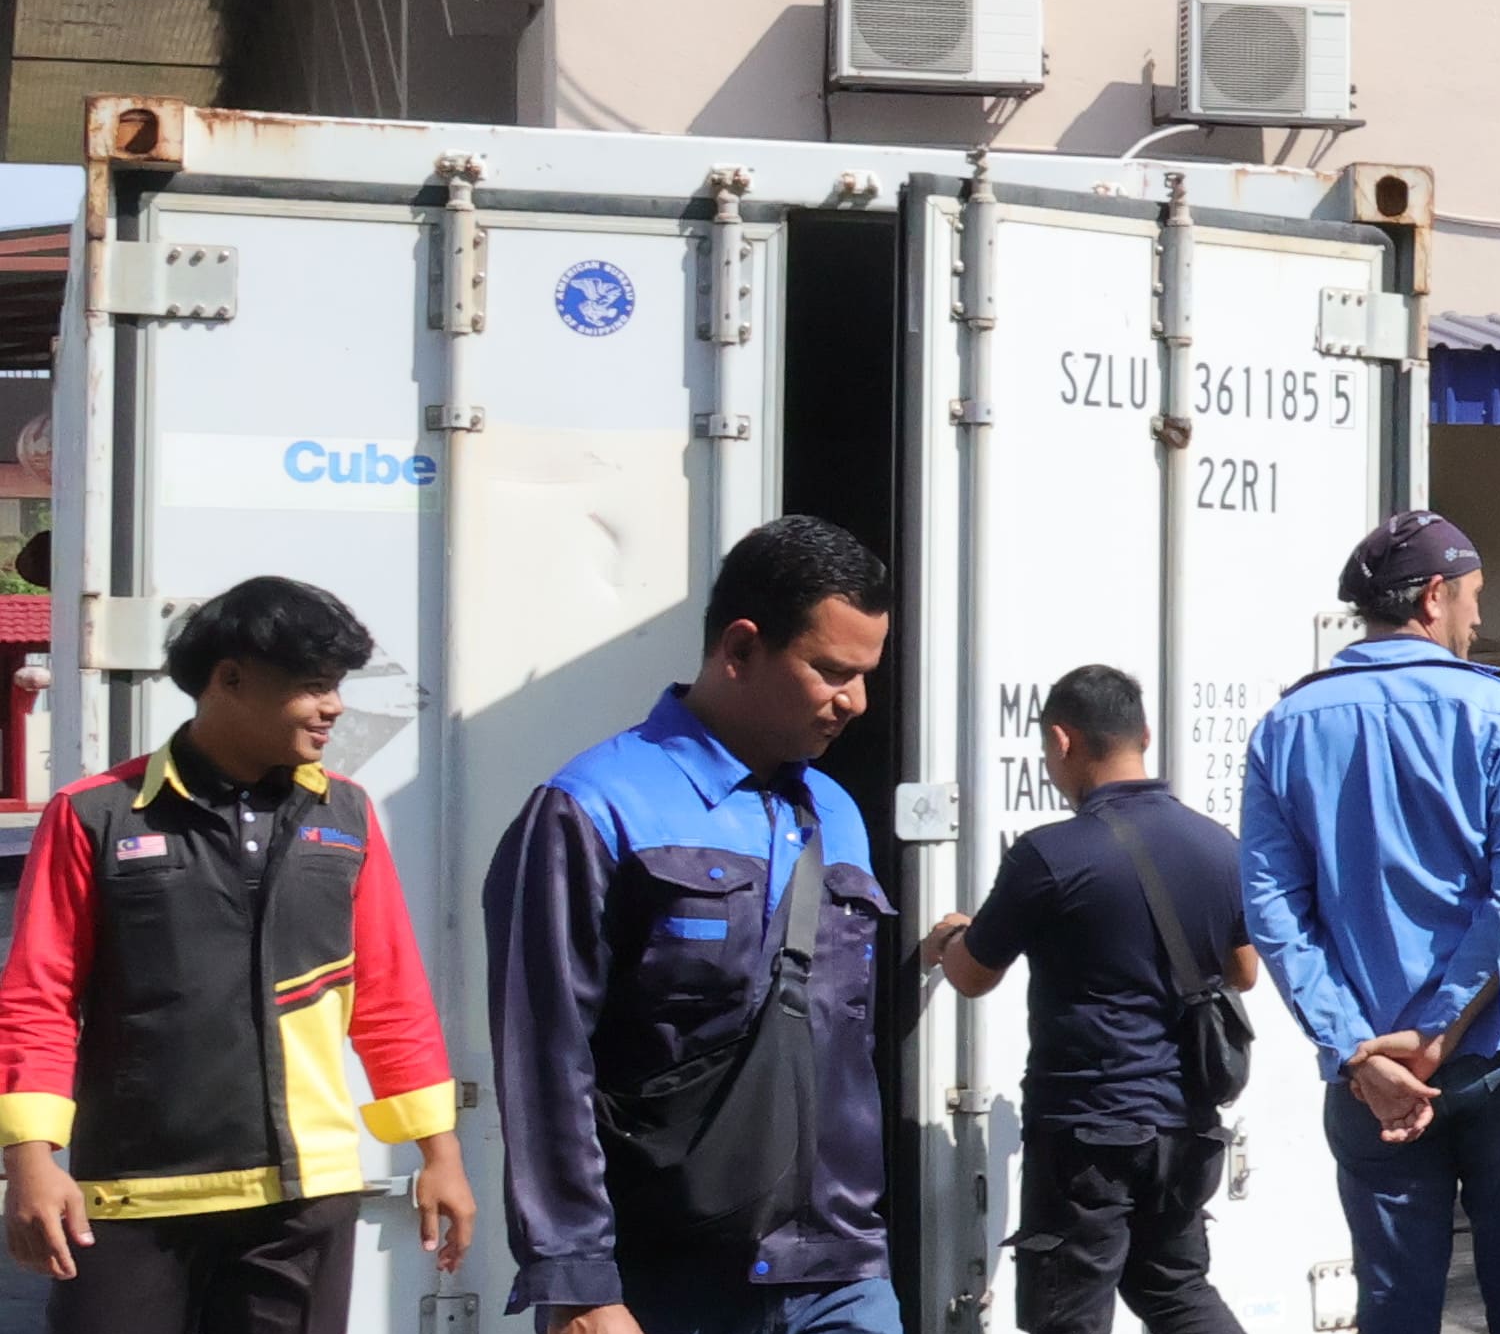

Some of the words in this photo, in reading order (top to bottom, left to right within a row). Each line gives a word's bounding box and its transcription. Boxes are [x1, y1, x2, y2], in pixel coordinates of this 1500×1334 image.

[1061, 351, 1147, 410] SZLU
[1195, 362, 1320, 422] 361185
[1333, 373, 1352, 425] 5
[284, 441, 436, 486] Cube
[1197, 457, 1278, 513] 22R1
